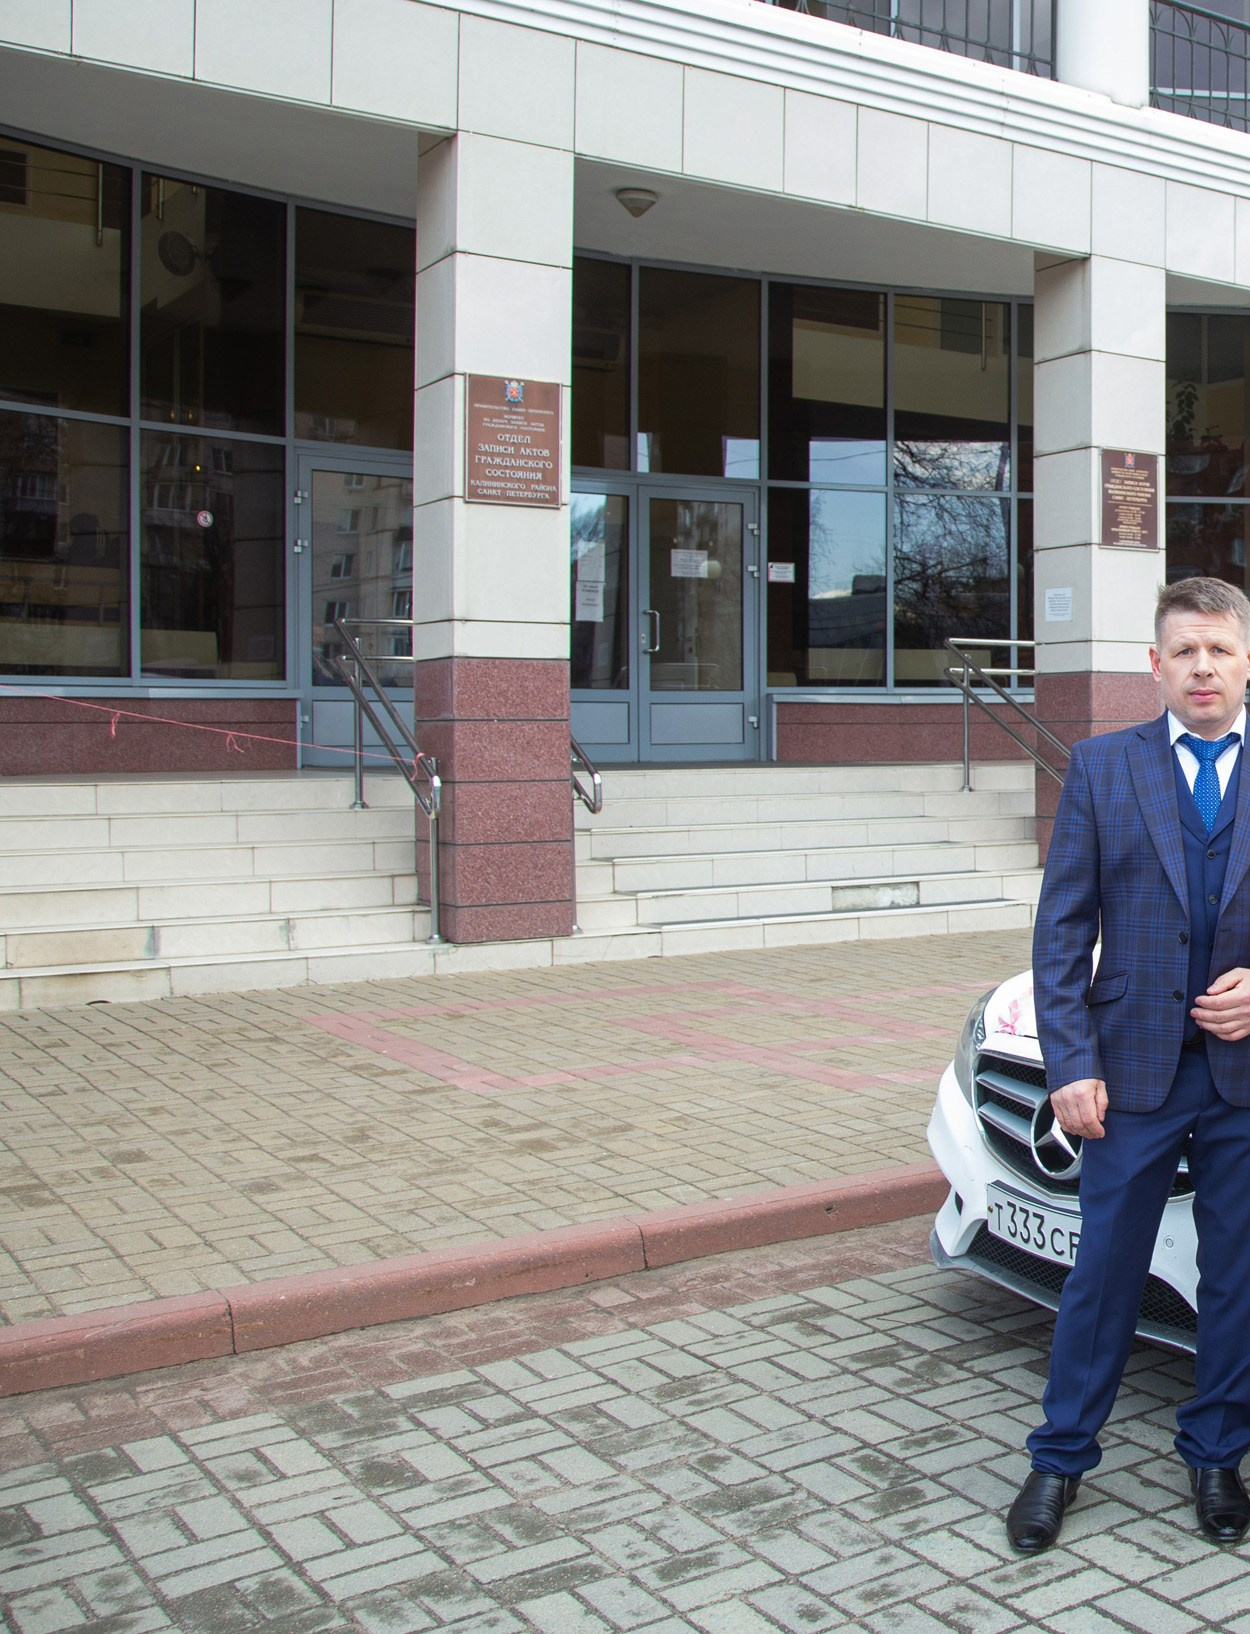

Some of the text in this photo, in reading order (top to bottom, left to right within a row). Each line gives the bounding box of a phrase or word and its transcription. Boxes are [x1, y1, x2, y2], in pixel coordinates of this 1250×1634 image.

[497, 433, 531, 444] ОТДЕЛ
[478, 443, 550, 457] ЗАПИСИ АКТОВ
[475, 455, 553, 469] ГРАЖДАНСКОГО
[485, 468, 543, 480] СОСТОЯНИЯ
[470, 479, 557, 492] КАЛИНИНСКОГО РАЙОНА
